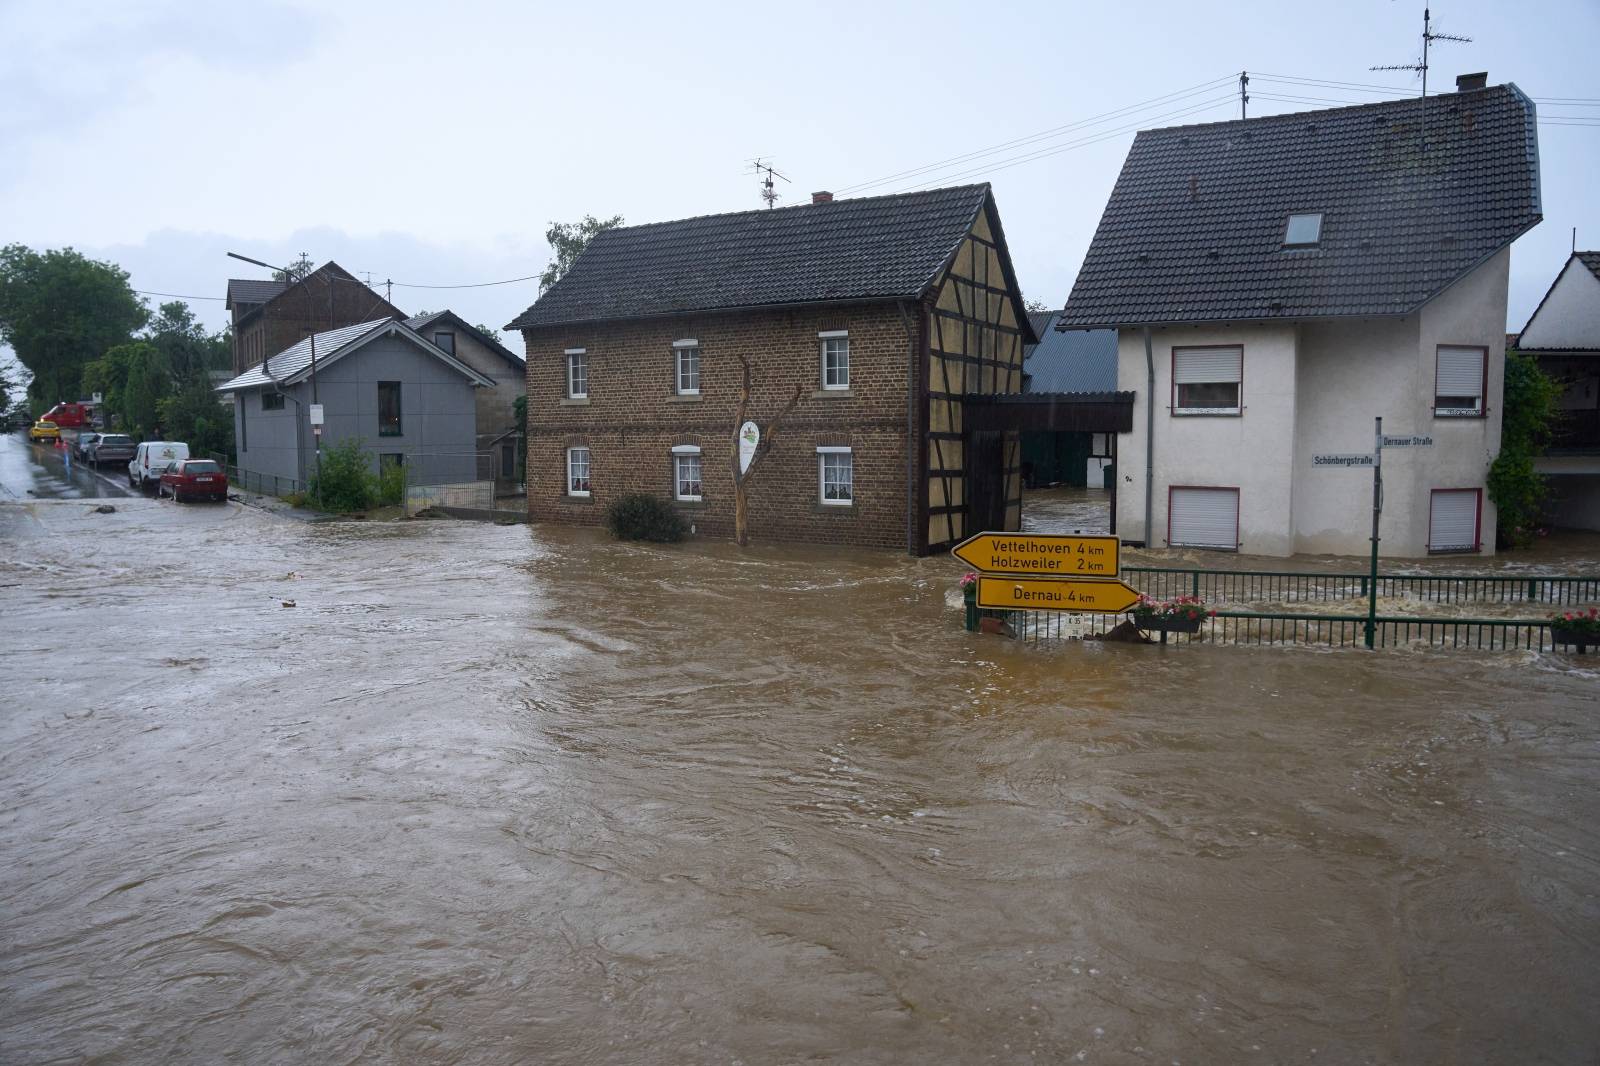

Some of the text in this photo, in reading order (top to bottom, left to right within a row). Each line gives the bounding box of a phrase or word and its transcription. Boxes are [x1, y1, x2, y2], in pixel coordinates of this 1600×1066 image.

[1383, 436, 1433, 446] Dernauer Straße
[1314, 455, 1373, 467] Schönbergstraße
[992, 540, 1104, 556] Vettelhoven 4 km
[991, 556, 1104, 571] Holzweiler 2 km
[1013, 588, 1095, 603] Dernau 4 km
